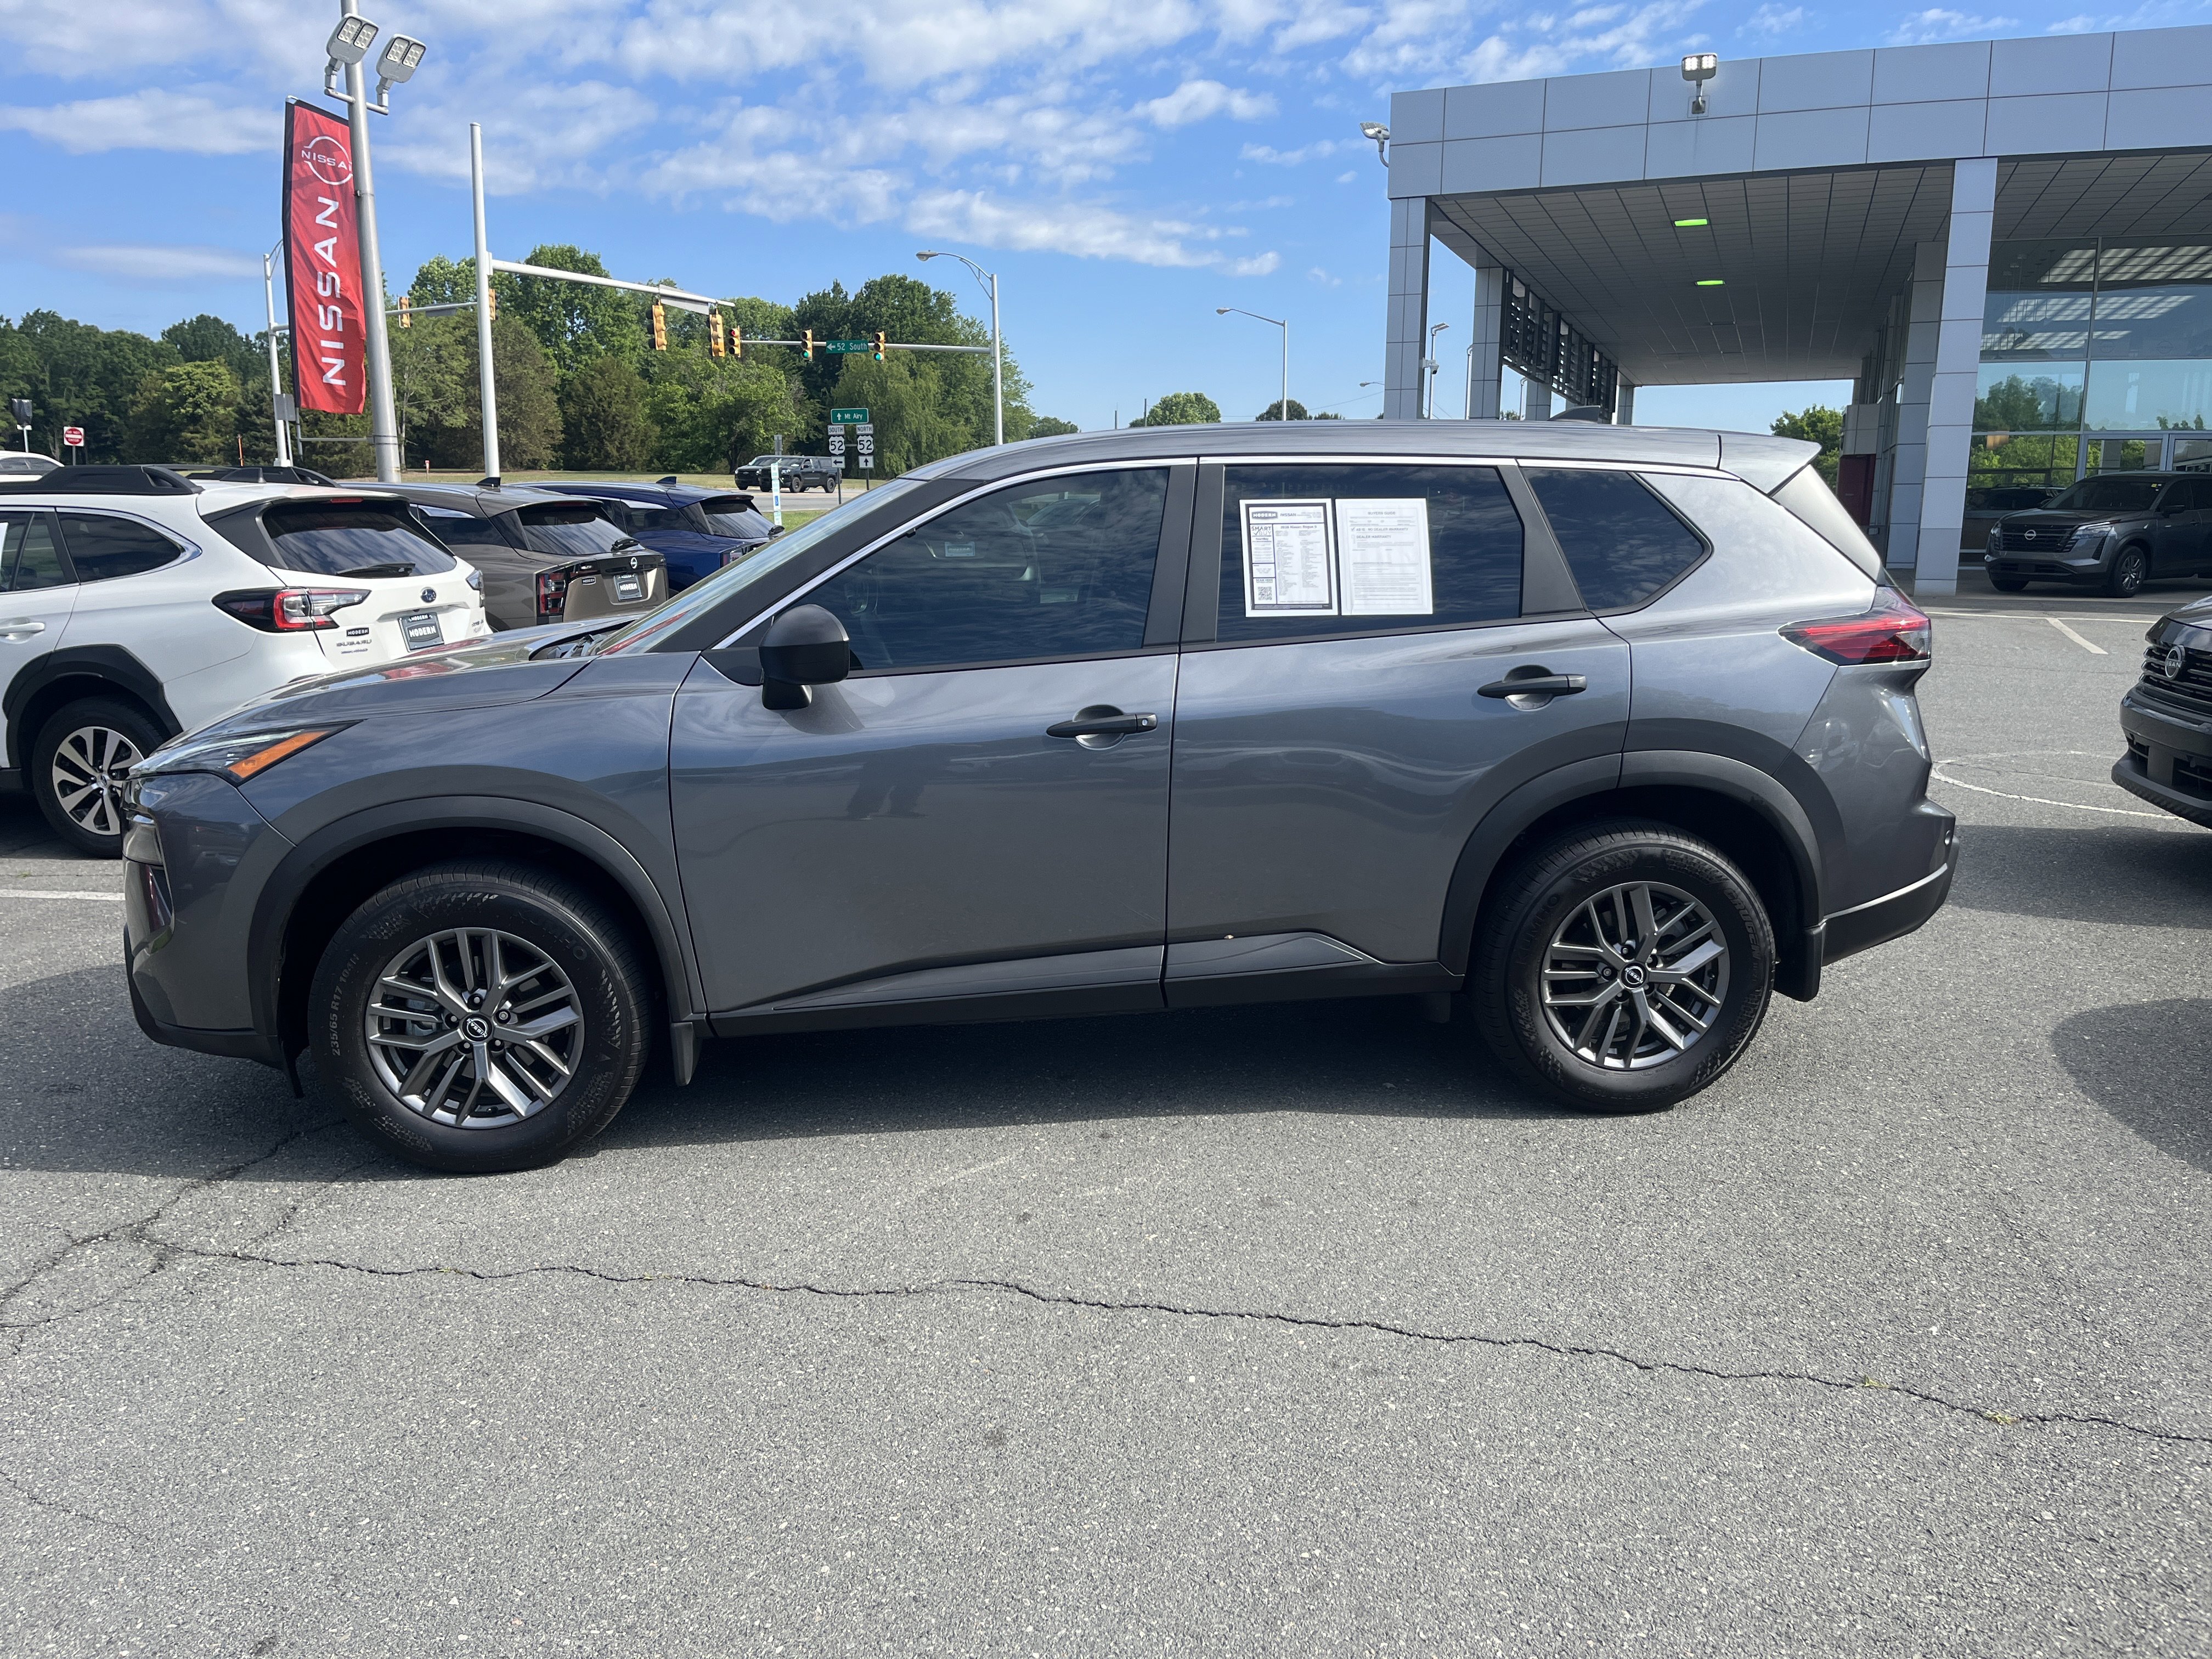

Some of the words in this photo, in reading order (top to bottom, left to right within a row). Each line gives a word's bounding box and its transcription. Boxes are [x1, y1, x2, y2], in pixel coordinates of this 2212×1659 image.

[314, 196, 346, 386] NISSAN
[837, 342, 845, 351] 52
[849, 342, 867, 351] South
[830, 440, 844, 451] 52
[859, 439, 872, 450] 52
[619, 583, 637, 591] MODERN
[409, 625, 436, 637] MODERN
[336, 639, 371, 647] SUBARU
[1724, 888, 1760, 960] CRUGEN
[331, 985, 343, 1011] R17
[466, 1018, 488, 1037] NISSAN
[330, 1013, 341, 1056] 235/65
